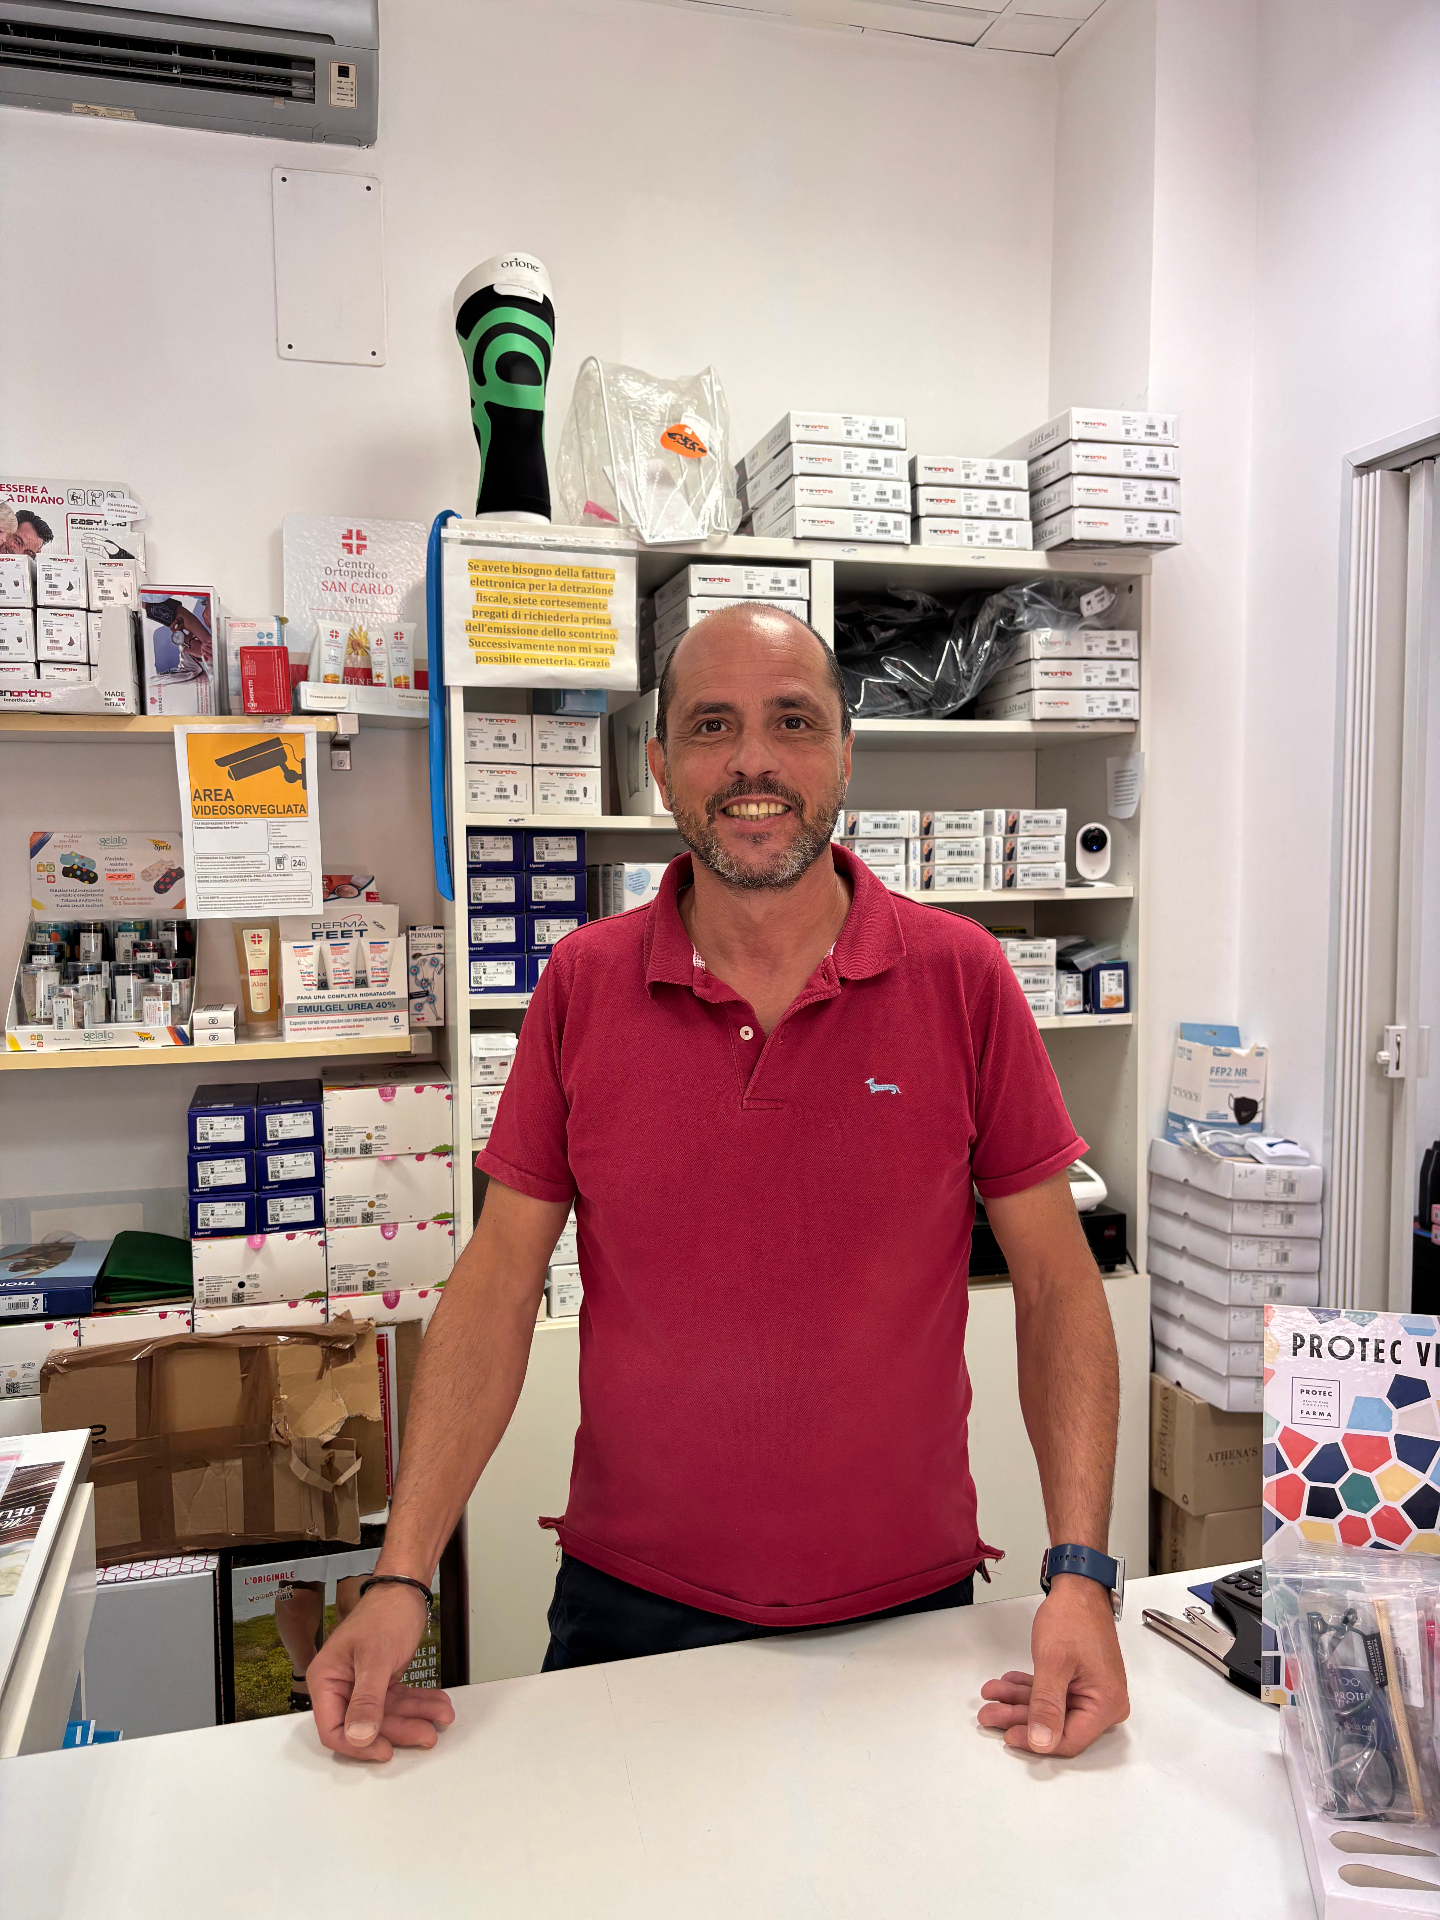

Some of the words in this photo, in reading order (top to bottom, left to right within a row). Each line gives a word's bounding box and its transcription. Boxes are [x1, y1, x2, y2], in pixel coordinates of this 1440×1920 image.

[500, 258, 540, 272] orione
[40, 486, 48, 494] A
[17, 494, 28, 504] DI
[30, 496, 64, 505] MANO
[337, 558, 375, 570] Centro
[324, 567, 388, 580] Ortopedico
[468, 562, 480, 571] Se
[481, 564, 510, 573] avete
[512, 565, 552, 577] bisogno
[554, 567, 579, 578] della
[582, 569, 616, 580] fattura
[321, 581, 348, 593] SAN
[351, 582, 394, 595] CARLO
[470, 577, 526, 590] elettronica
[528, 583, 546, 592] per
[549, 582, 557, 592] la
[560, 584, 614, 596] detrazione
[345, 596, 368, 605] Voltri
[476, 592, 511, 605] fiscale,
[513, 596, 538, 605] siete
[540, 598, 608, 610] cortesemente
[472, 608, 508, 619] pregati
[511, 609, 521, 619] di
[524, 610, 579, 622] richiederla
[581, 614, 612, 626] prima
[465, 622, 539, 636] dell'emissione
[541, 628, 566, 638] dello
[568, 629, 618, 640] scontrino.
[468, 638, 555, 652] Successivamente
[557, 644, 576, 652] non
[579, 644, 591, 653] mi
[594, 645, 615, 655] sarà
[475, 653, 522, 665] possibile
[524, 656, 576, 666] emetterla.
[578, 659, 610, 668] Grazie
[0, 690, 52, 698] enortho
[193, 788, 234, 802] AREA
[193, 804, 306, 816] VIDEOSORVEGLIATA
[311, 920, 368, 930] DERMA
[312, 929, 368, 940] FEET
[297, 1005, 344, 1013] EMULGEL
[394, 1015, 400, 1024] 6
[1210, 1066, 1232, 1076] FFP2
[1234, 1068, 1247, 1077] NR
[1292, 1332, 1402, 1365] PROTEC
[1300, 1389, 1333, 1397] PROTEC
[1206, 1447, 1258, 1463] ATHENA'S
[244, 1571, 295, 1585] L'ORIGINALE
[248, 1585, 293, 1603] WOODSTOCK
[280, 1592, 294, 1601] IRIS
[429, 1646, 436, 1656] IN
[408, 1658, 427, 1669] ENZA
[429, 1657, 436, 1667] DI
[409, 1669, 439, 1680] GONFIE.
[422, 1679, 437, 1689] CON
